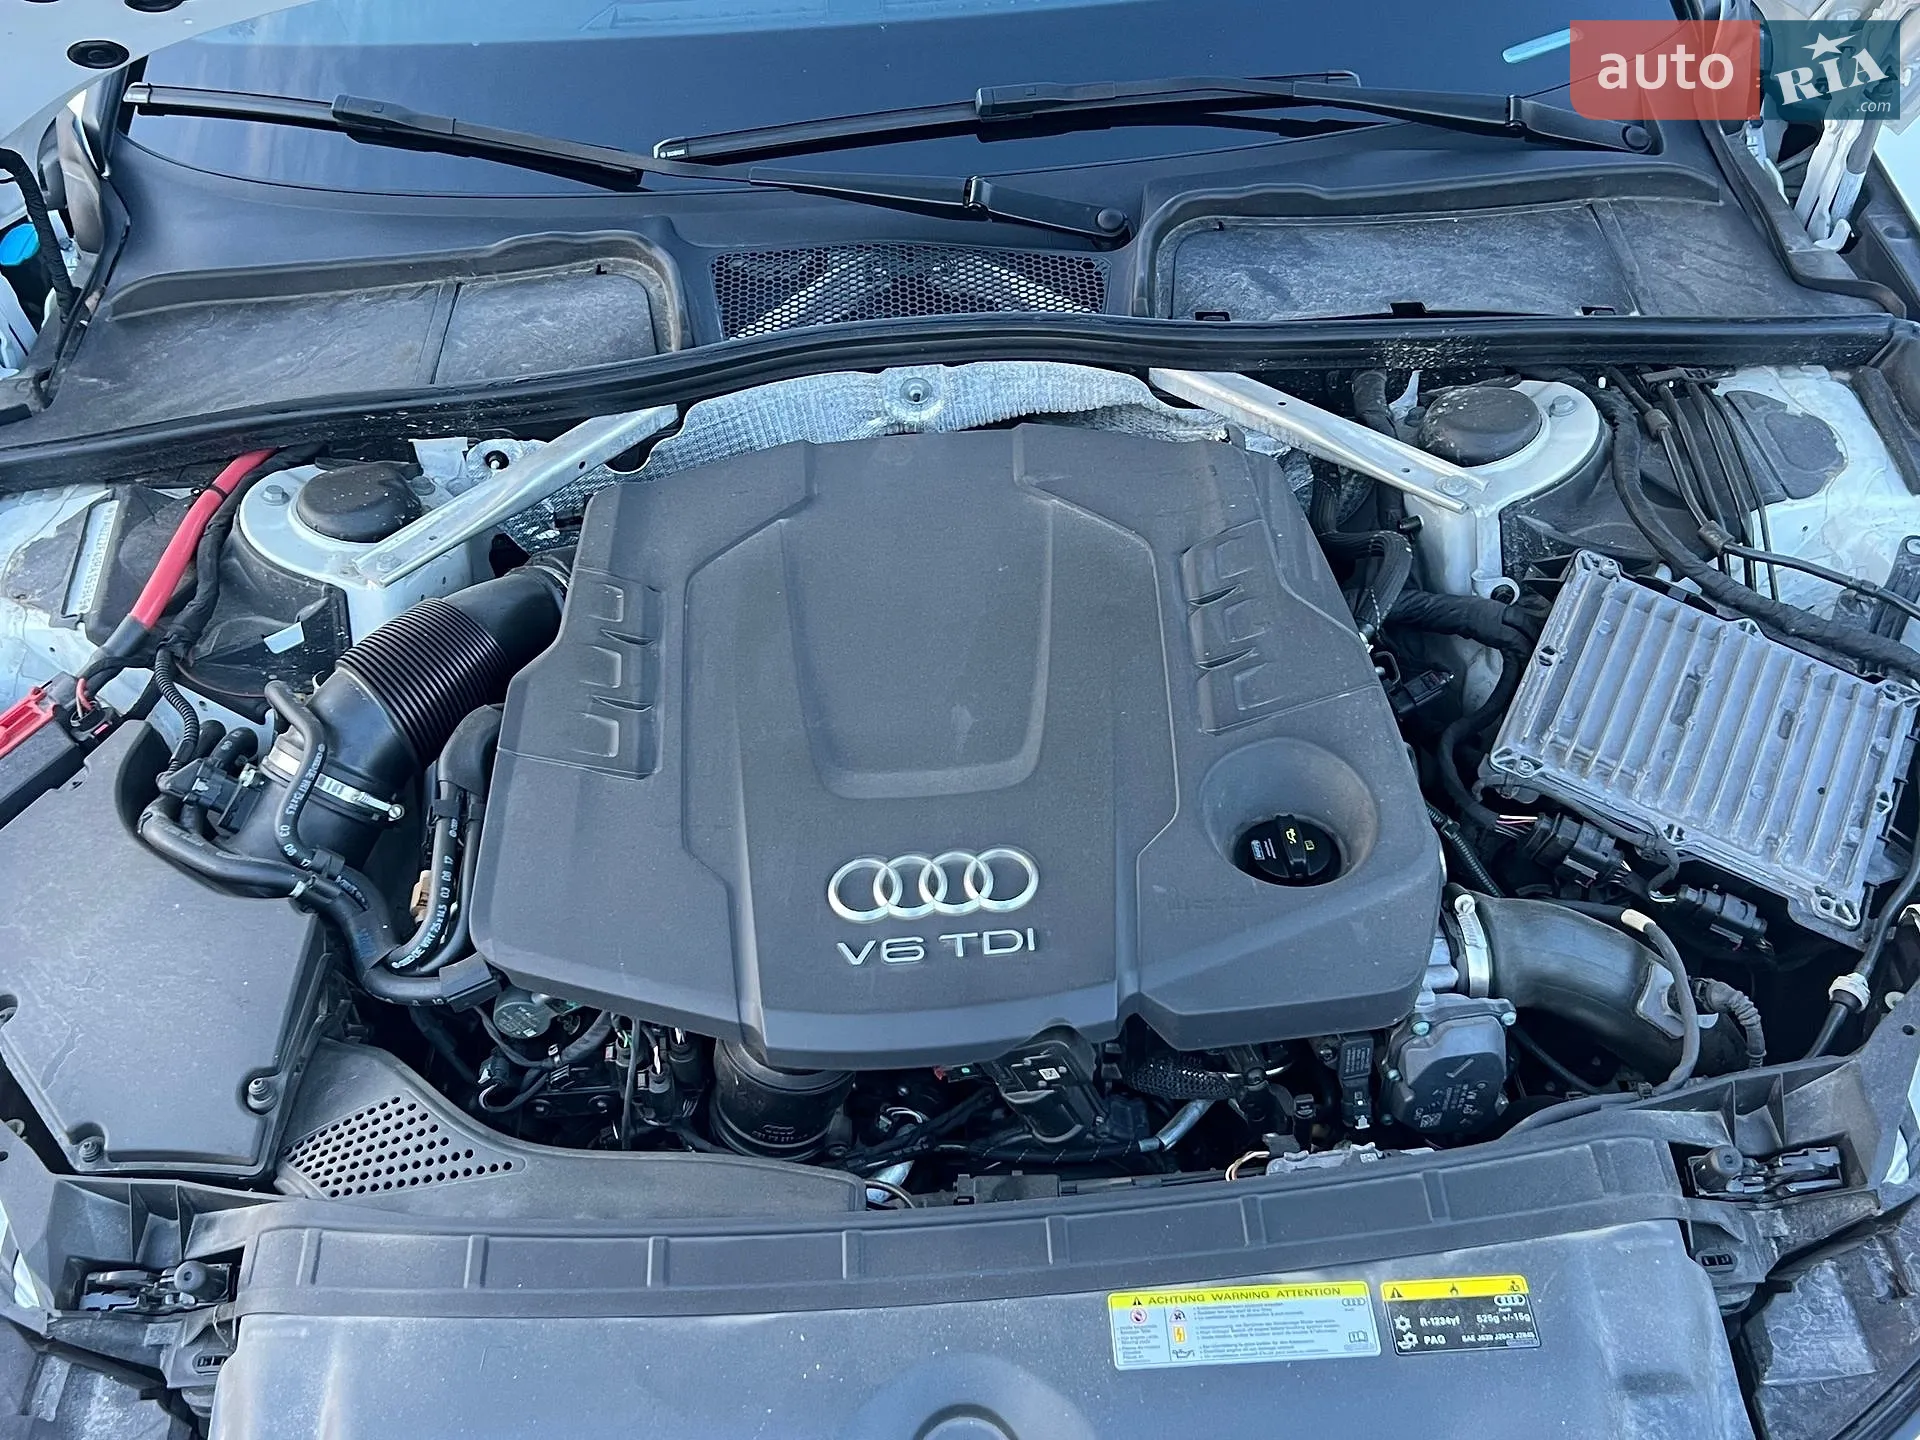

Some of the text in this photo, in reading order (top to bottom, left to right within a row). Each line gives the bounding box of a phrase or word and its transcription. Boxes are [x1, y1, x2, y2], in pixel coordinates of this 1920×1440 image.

[836, 927, 1036, 966] V6 TDI
[1148, 1287, 1341, 1306] ACHTUNG WARNING ATTENTION
[1423, 1334, 1447, 1345] PAG
